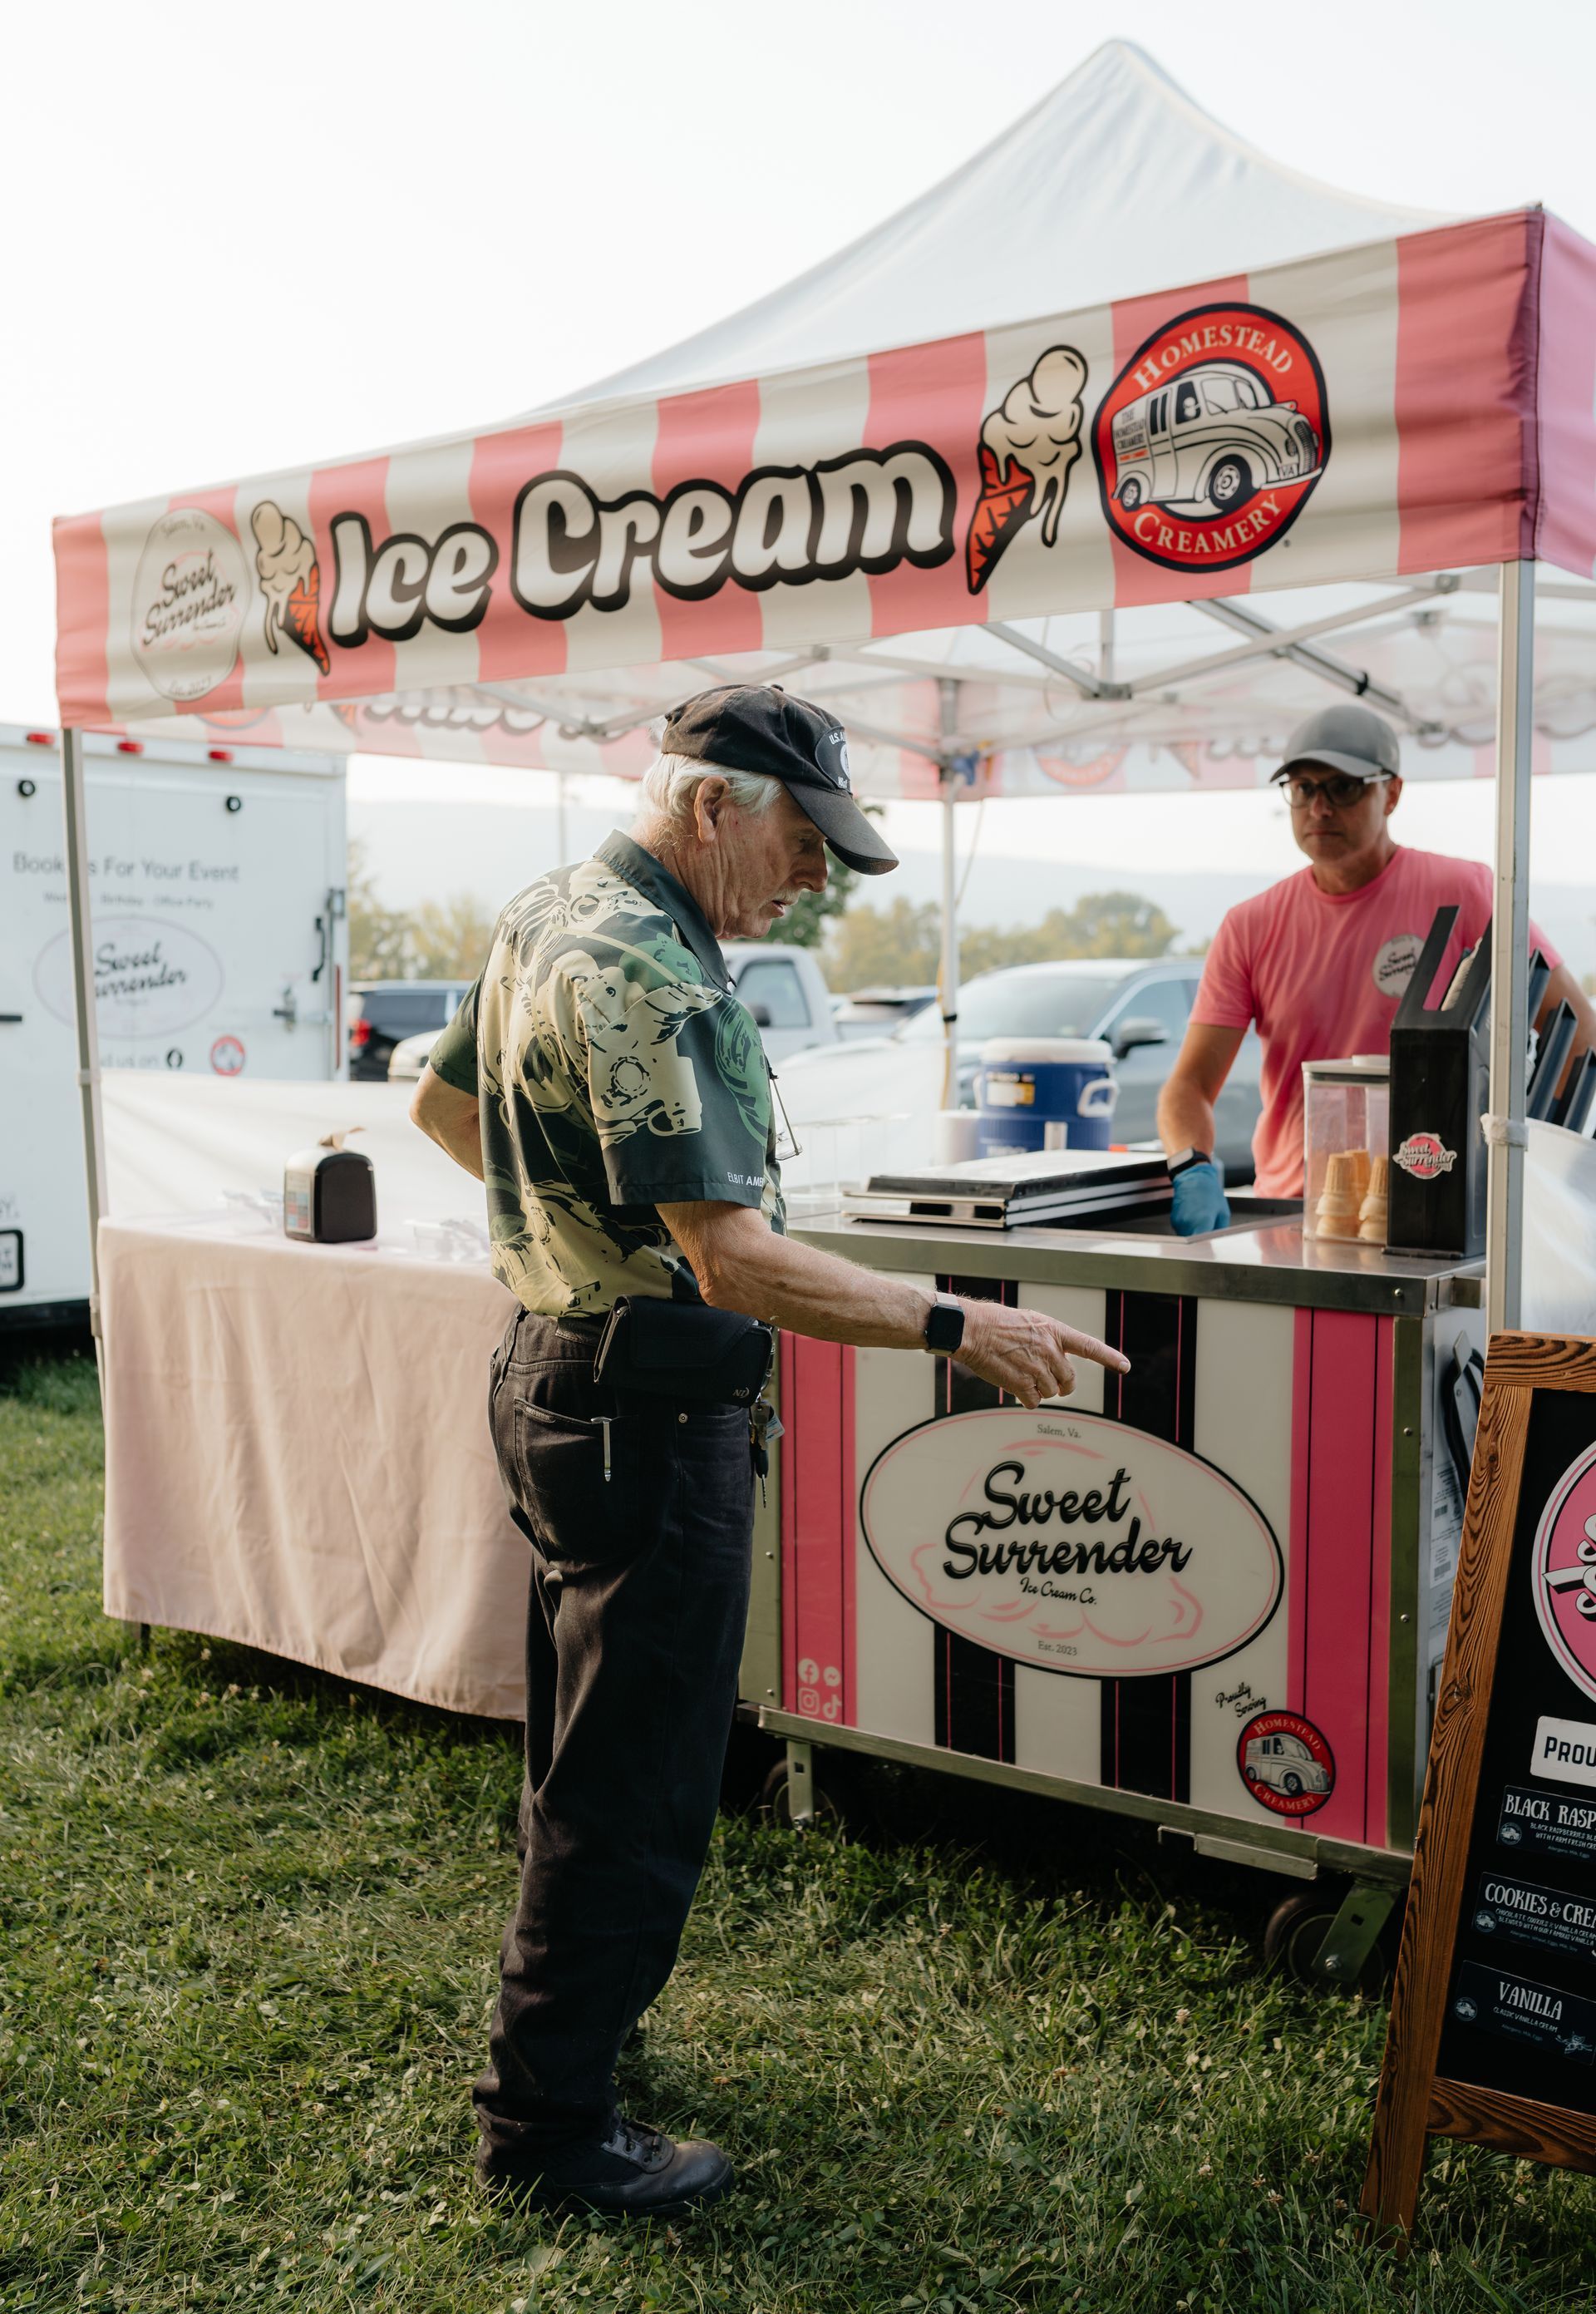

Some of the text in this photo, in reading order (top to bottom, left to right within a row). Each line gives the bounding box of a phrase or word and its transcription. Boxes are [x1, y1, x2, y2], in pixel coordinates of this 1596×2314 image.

[1131, 324, 1293, 391] HOMESTEAD
[1133, 493, 1283, 553] CREAMERY
[328, 440, 957, 649] Ice Cream
[162, 548, 215, 608] Sweet
[144, 577, 237, 645] Surrender
[13, 851, 65, 874] Book
[103, 856, 135, 877] For
[140, 859, 182, 880] Your
[189, 860, 239, 882] Event
[96, 940, 162, 977] Sweet
[95, 963, 187, 999] urrender
[727, 1172, 744, 1185] ELBIT
[1037, 1423, 1082, 1439] Salem, Va.
[981, 1461, 1131, 1529] Sweet
[943, 1512, 1194, 1579] Surrender
[1020, 1576, 1098, 1606] Ice Cream Co.
[1038, 1640, 1078, 1656] Est. 2023
[1215, 1681, 1251, 1709] Proudly
[1234, 1696, 1267, 1718] Serving
[1253, 1717, 1321, 1751] HOMESTEAD
[1254, 1783, 1317, 1811] CREAMERY
[1504, 1793, 1550, 1821] BLACK
[1485, 1882, 1548, 1916] COOKIES
[1549, 1902, 1561, 1917] &
[1499, 1981, 1563, 2021] VANILLA
